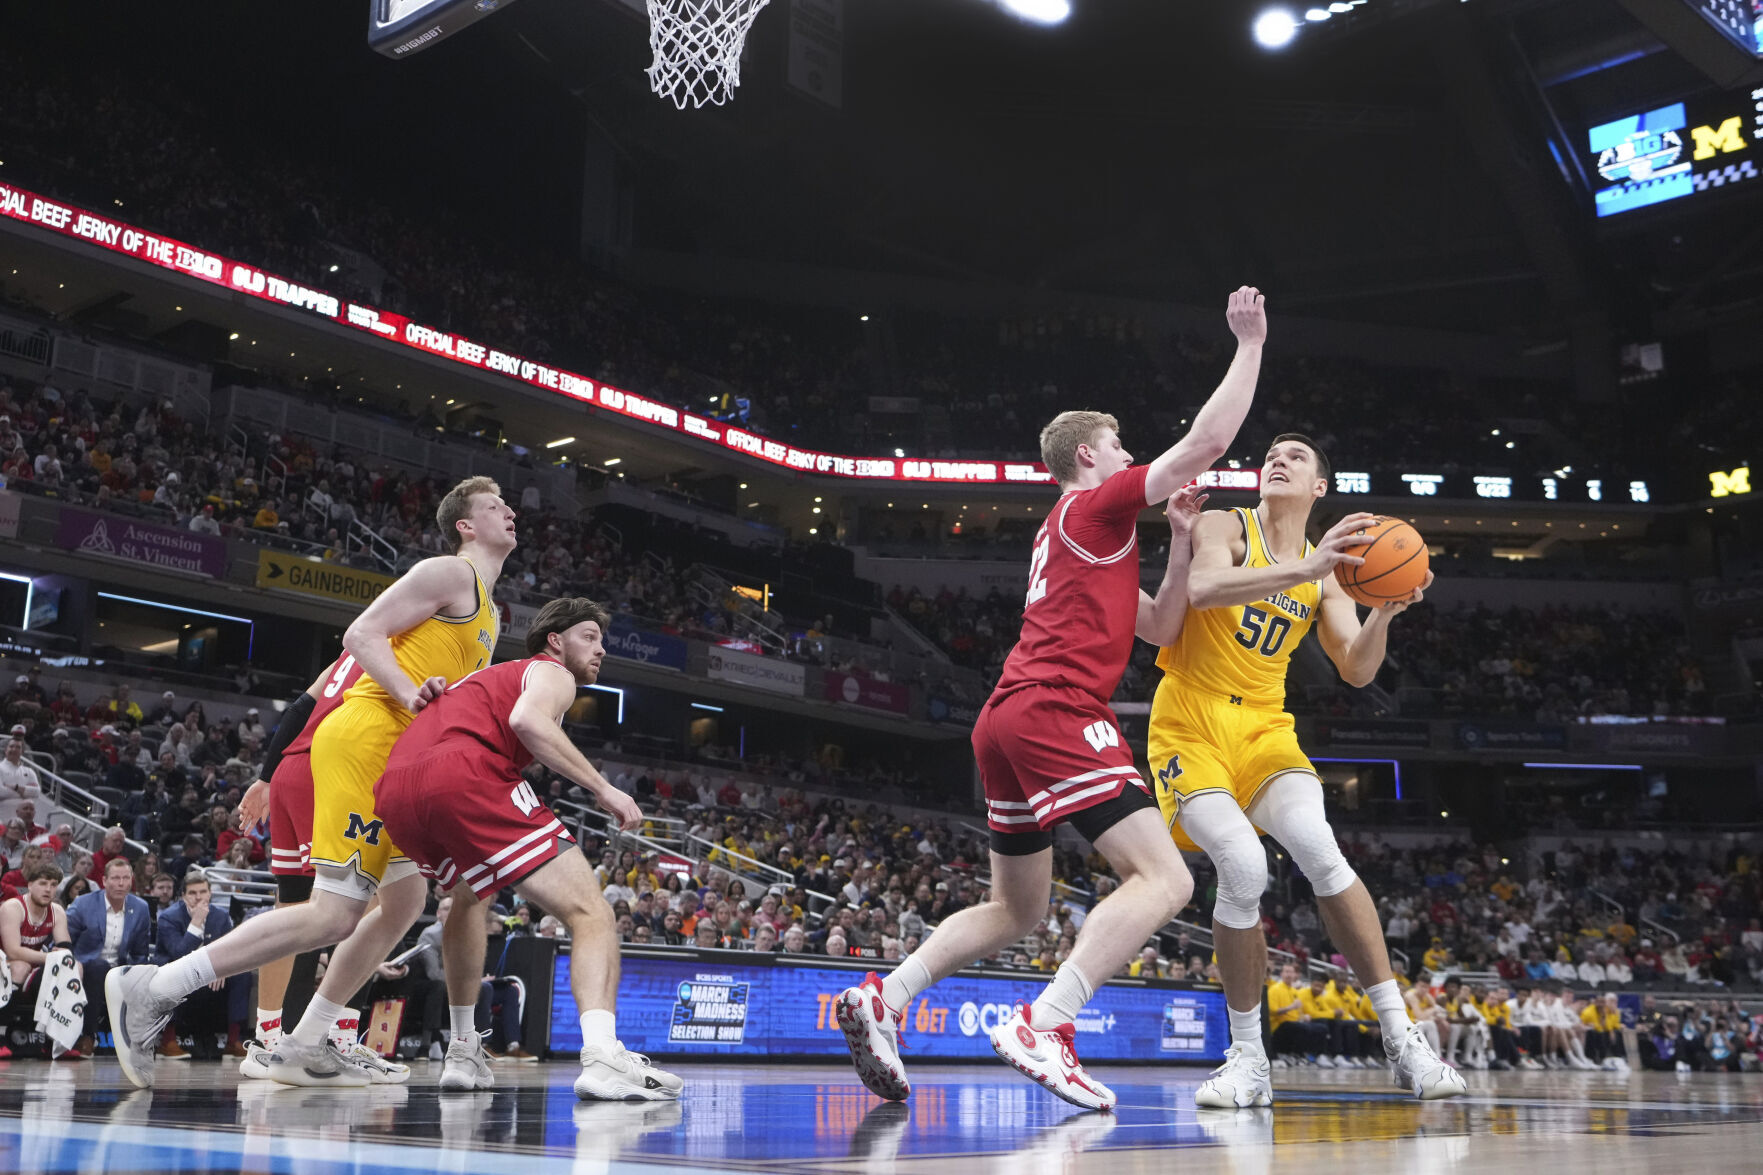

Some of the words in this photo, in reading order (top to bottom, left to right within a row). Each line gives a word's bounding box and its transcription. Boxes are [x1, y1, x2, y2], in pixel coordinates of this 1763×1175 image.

[1692, 116, 1748, 160] M
[32, 199, 72, 228] BEEF
[73, 215, 121, 245] JERKY
[123, 230, 144, 252] OF
[146, 236, 174, 263] THE
[233, 266, 265, 292] OLD
[267, 277, 338, 317] TRAPPER
[406, 324, 456, 355] OFFICIAL
[457, 340, 485, 363] BEEF
[486, 351, 521, 375] JERKY
[522, 361, 537, 380] OF
[537, 366, 558, 388] THE
[600, 387, 624, 409] OLD
[625, 395, 677, 426] TRAPPER
[727, 429, 764, 454] OFFICIAL
[765, 441, 786, 461] BEEF
[786, 449, 816, 468] JERKY
[817, 455, 832, 471] OF
[833, 457, 854, 475] THE
[903, 462, 931, 477] OLD
[932, 463, 995, 479] TRAPPER
[1709, 467, 1751, 498] M
[123, 525, 202, 553] Ascension
[120, 542, 140, 560] St.
[143, 546, 202, 571] Vincent
[289, 565, 388, 600] GAINBRIDG
[622, 633, 659, 662] Kroger
[1235, 605, 1292, 657] 50
[324, 655, 355, 698] 9
[1230, 694, 1243, 705] M
[1083, 720, 1119, 752] W
[1158, 755, 1183, 793] M
[510, 780, 540, 818] W
[344, 812, 383, 846] M
[690, 985, 730, 1002] MARCH
[694, 1002, 746, 1020] MADNESS
[980, 1003, 1023, 1035] CB
[671, 1025, 716, 1040] SELECTION
[717, 1026, 743, 1040] SHOW
